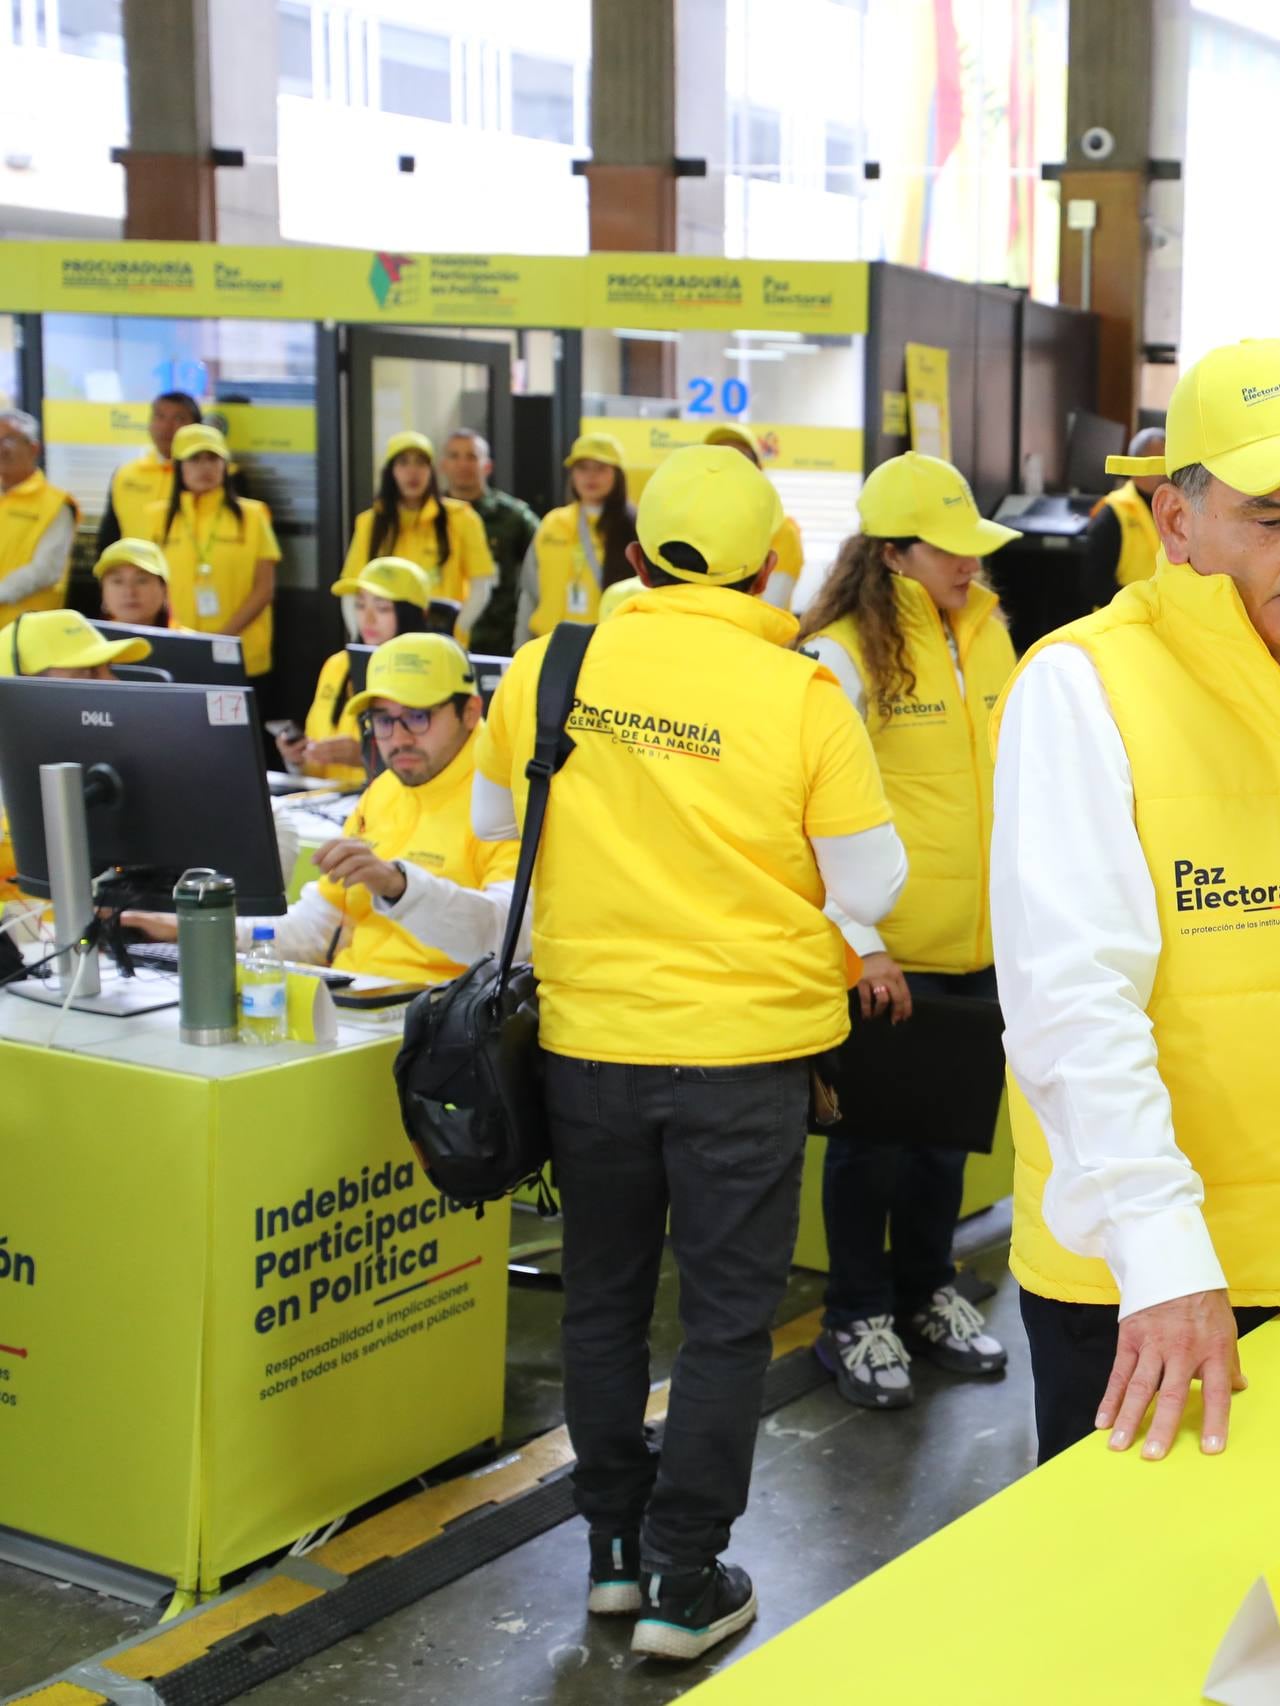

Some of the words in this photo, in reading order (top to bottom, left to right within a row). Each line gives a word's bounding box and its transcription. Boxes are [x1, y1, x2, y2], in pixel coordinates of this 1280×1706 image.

[687, 377, 749, 416] 20
[81, 710, 114, 727] DELL
[212, 694, 243, 722] 17
[621, 729, 639, 741] DE
[643, 734, 661, 745] LA
[666, 738, 721, 757] NACIÓN
[1174, 859, 1226, 888] Paz
[1180, 927, 1190, 935] La
[1191, 924, 1234, 936] protección
[1235, 922, 1246, 930] de
[1247, 920, 1258, 928] las
[255, 1161, 414, 1242] Indebida
[254, 1293, 300, 1335] en
[309, 1239, 438, 1314] Política
[265, 1319, 375, 1377] Responsabilidad
[376, 1316, 385, 1329] e
[386, 1281, 470, 1325] implicaciones
[259, 1374, 298, 1401] sobre
[301, 1357, 338, 1384] todos
[340, 1347, 360, 1367] los
[361, 1319, 424, 1358] servidores
[426, 1296, 477, 1332] públicos
